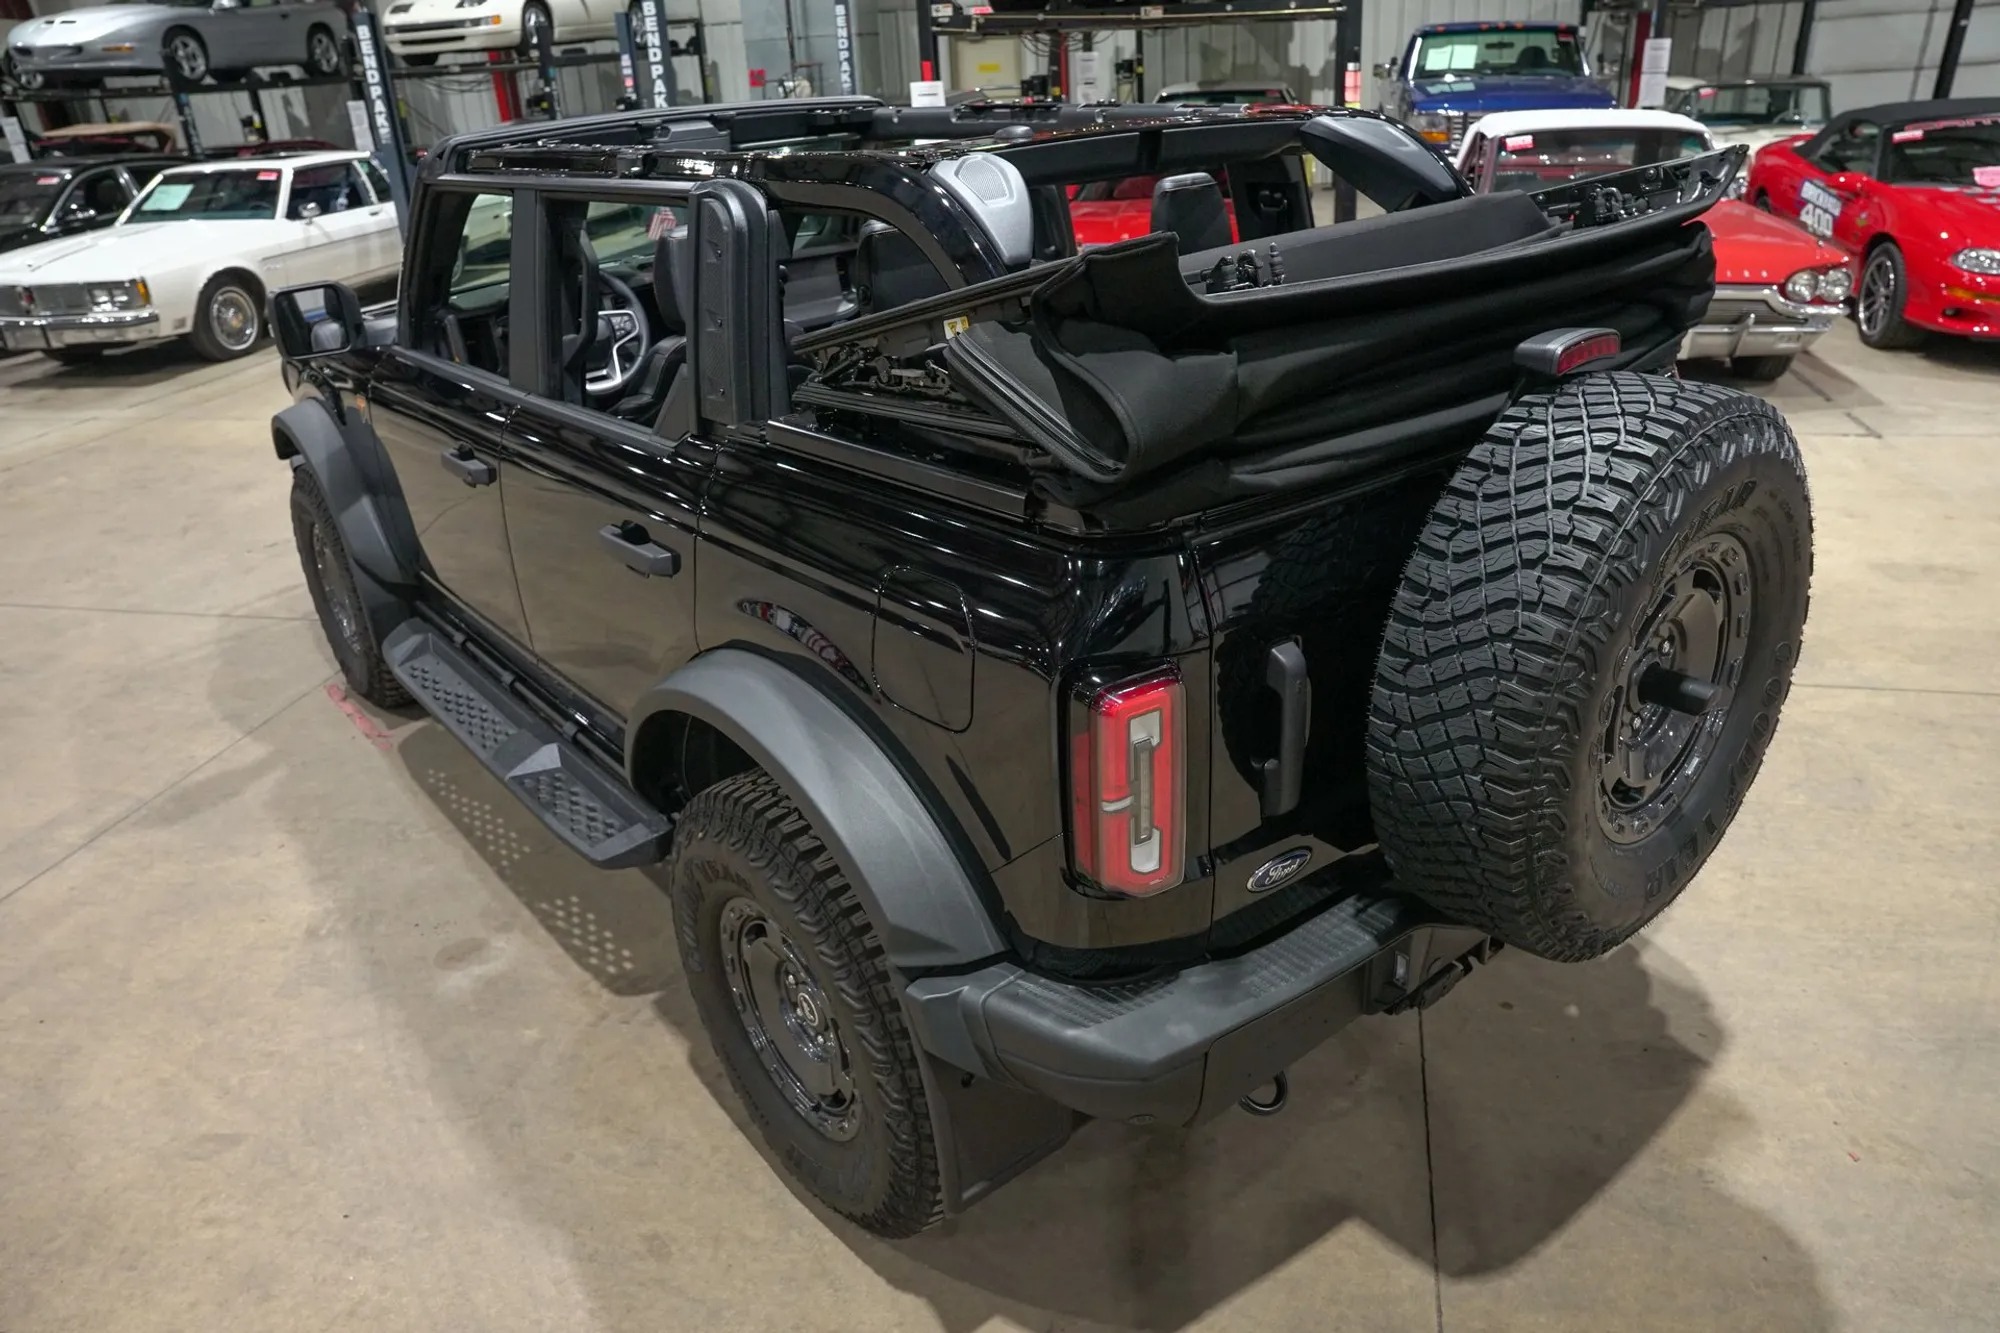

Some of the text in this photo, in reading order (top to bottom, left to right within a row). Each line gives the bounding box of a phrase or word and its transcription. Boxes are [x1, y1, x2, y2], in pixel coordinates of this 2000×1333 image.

[356, 25, 390, 129] BENDPAK
[642, 1, 669, 108] BENDPAK
[835, 4, 851, 84] BENDPAK
[1800, 203, 1833, 238] 400
[1265, 859, 1300, 884] Ford
